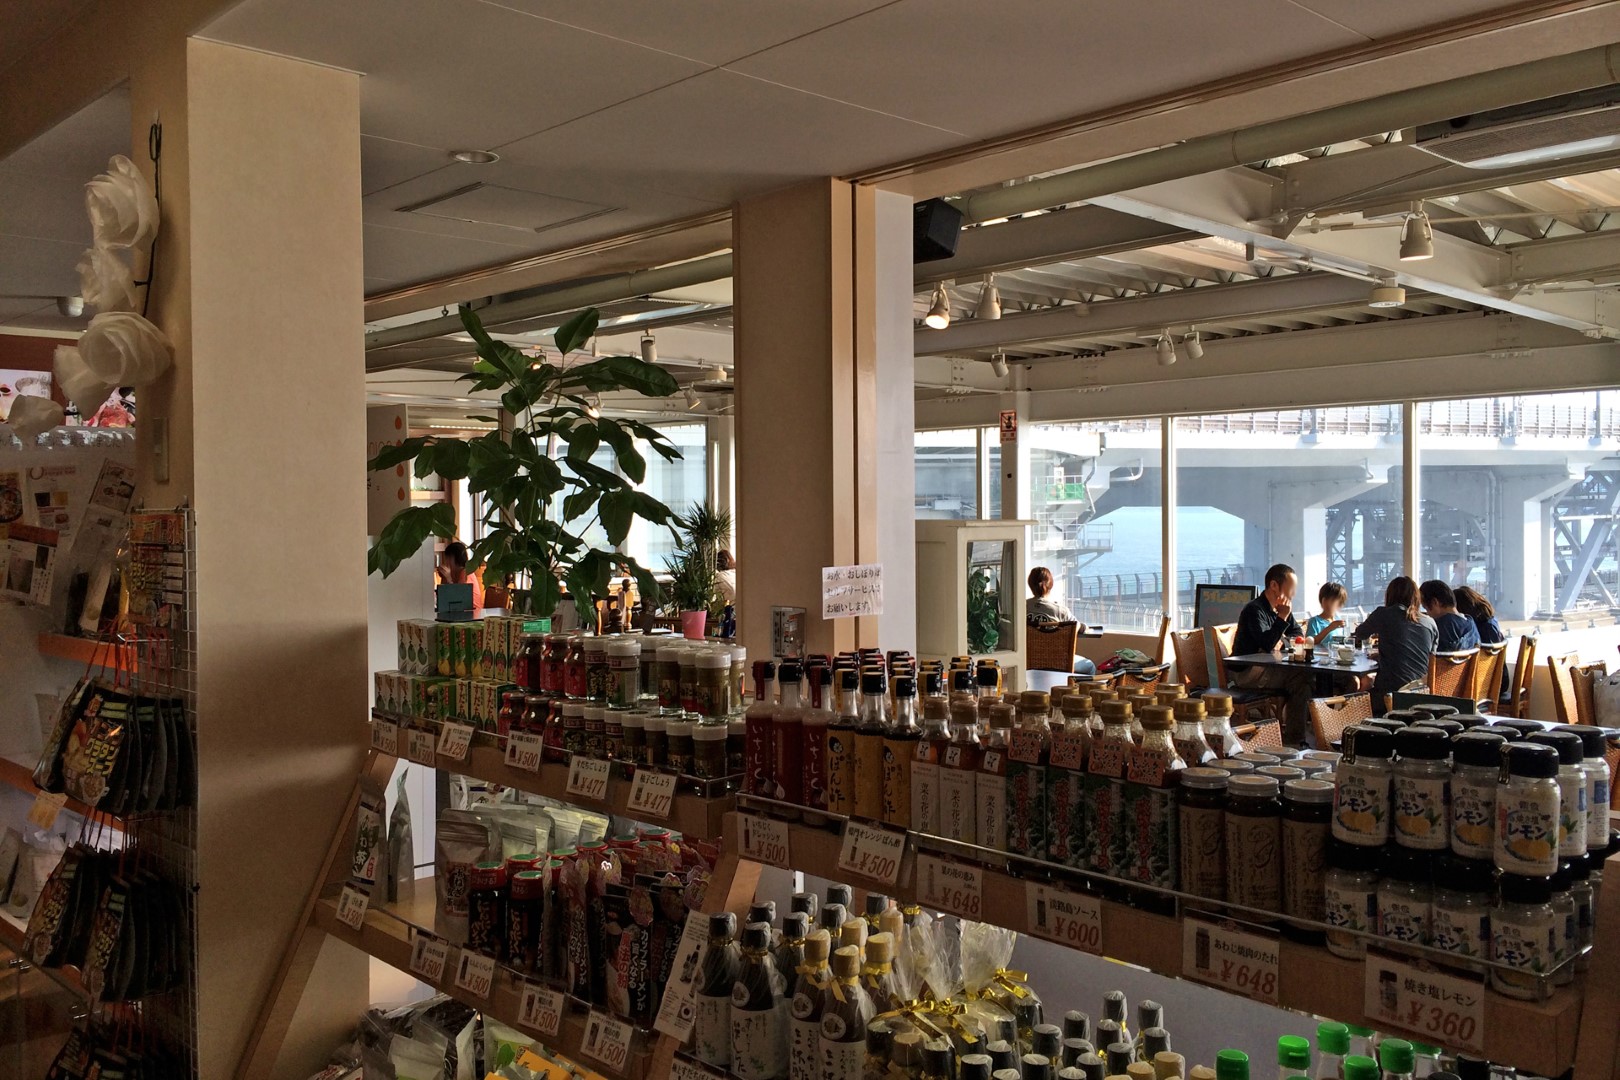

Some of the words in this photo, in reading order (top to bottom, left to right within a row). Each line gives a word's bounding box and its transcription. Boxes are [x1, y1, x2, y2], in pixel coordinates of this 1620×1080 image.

[752, 724, 766, 780] いちじく
[808, 732, 821, 790] いちじく
[580, 776, 605, 795] ¥477
[643, 791, 671, 812] ¥477
[1340, 797, 1373, 813] レモン
[1454, 808, 1489, 826] レモン
[1507, 822, 1547, 841] レモン
[757, 840, 786, 863] ¥500
[859, 852, 896, 878] ¥500
[941, 887, 980, 914] ¥648
[1055, 917, 1099, 946] ¥600
[1383, 924, 1419, 942] レモン
[1214, 938, 1278, 965] あわじ焼肉のたれ
[1495, 947, 1532, 967] レモン
[637, 928, 649, 1012] カップラーメンが
[1220, 959, 1276, 995] ¥648
[1404, 976, 1477, 1007] 焼き塩レモン
[533, 1008, 558, 1031] ¥500
[1406, 1000, 1476, 1041] ¥360
[598, 1040, 626, 1066] ¥500
